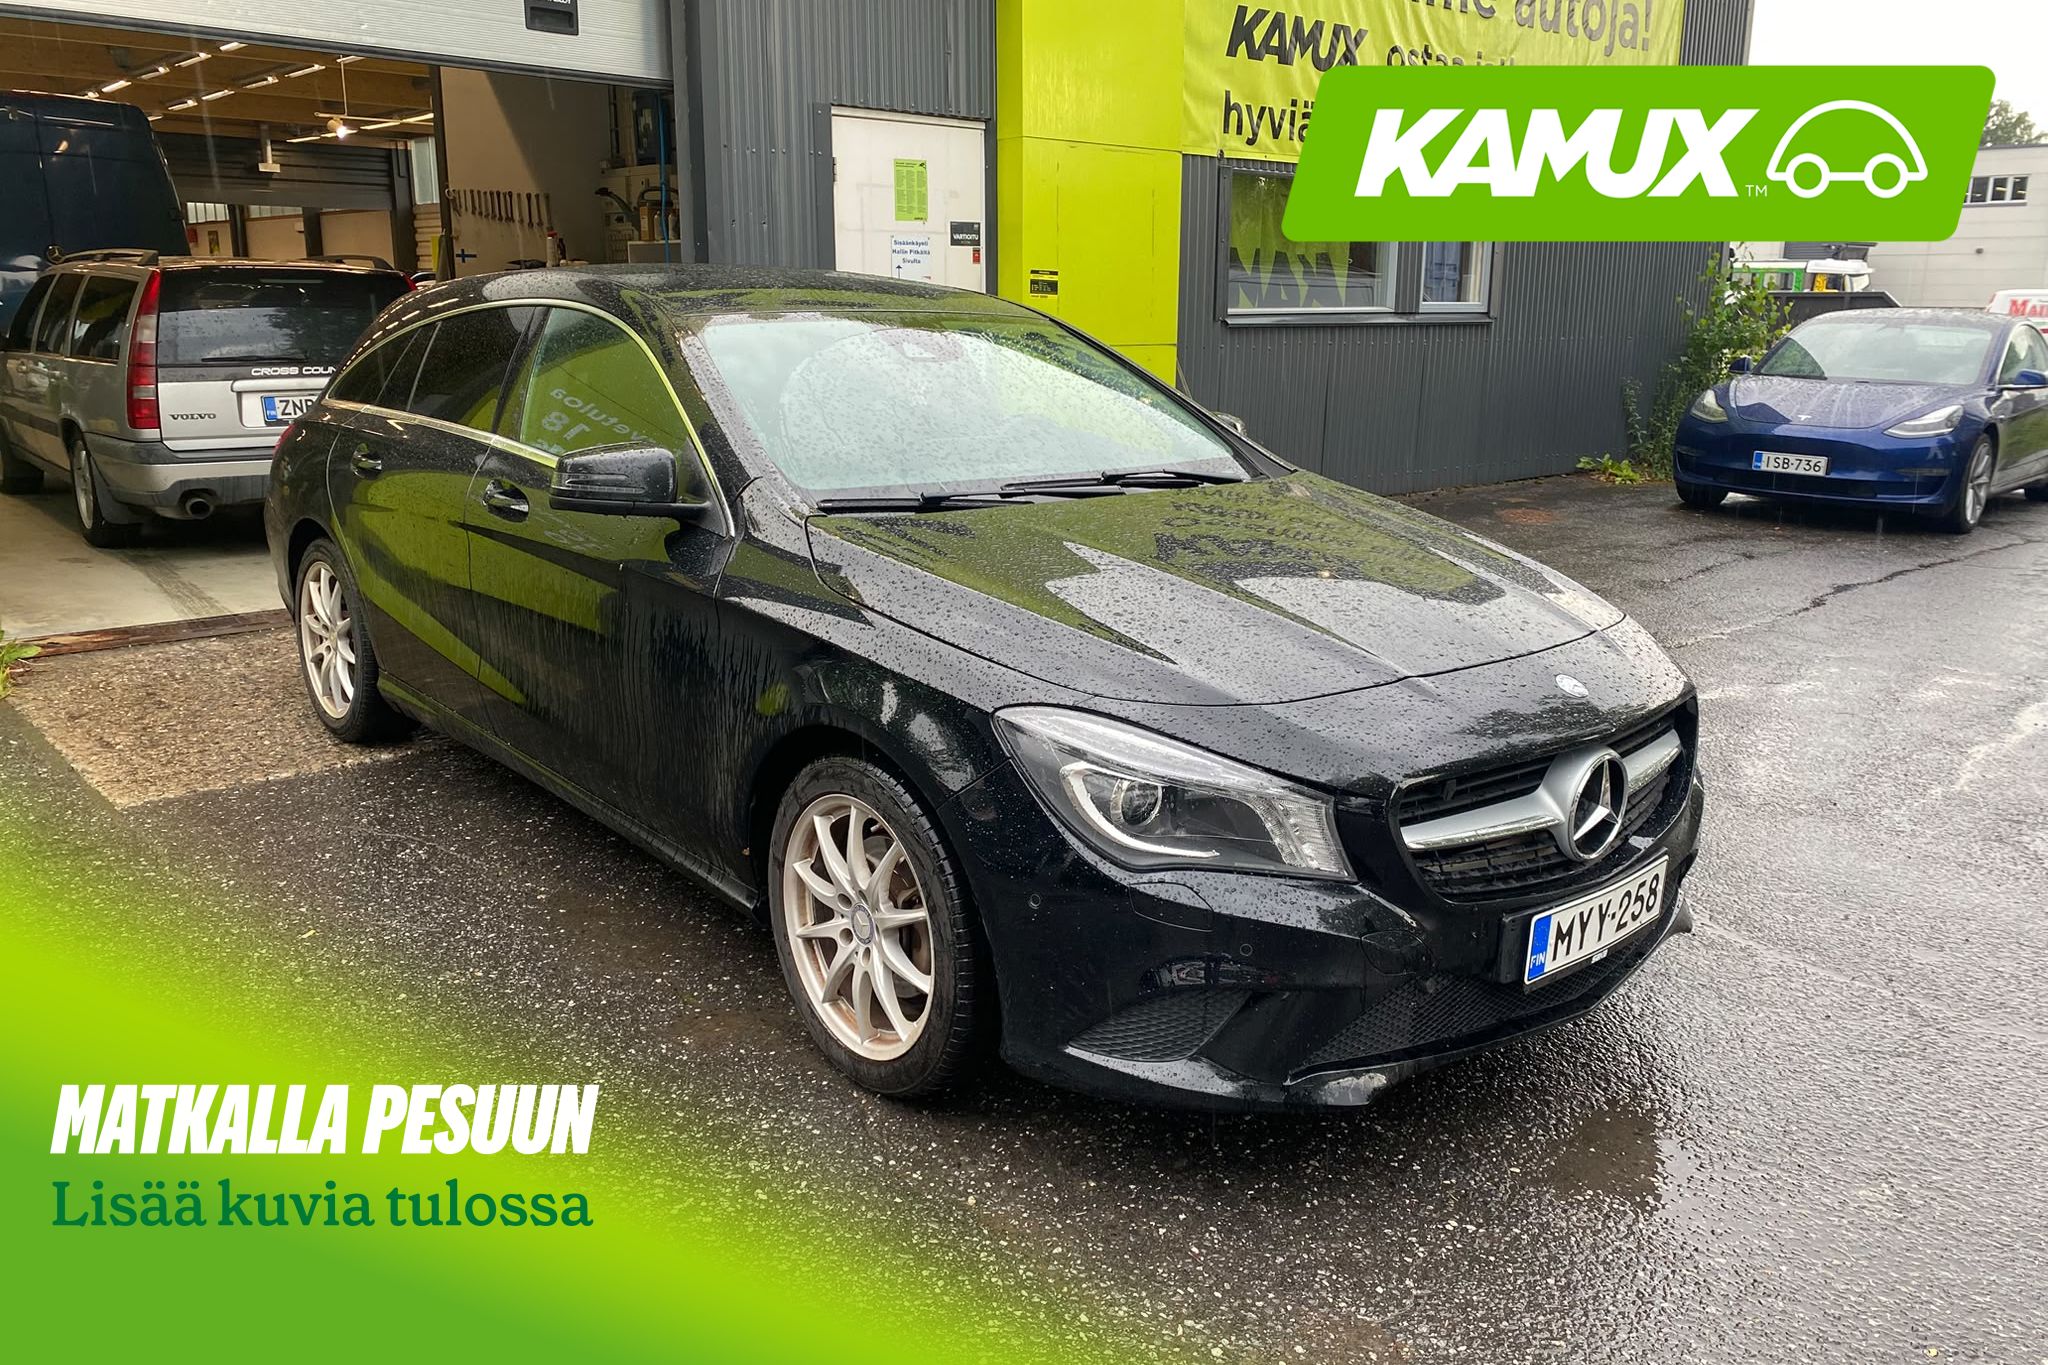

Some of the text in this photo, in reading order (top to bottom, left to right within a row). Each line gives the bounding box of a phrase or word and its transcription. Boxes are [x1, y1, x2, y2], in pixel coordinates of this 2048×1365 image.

[1225, 4, 1368, 72] KAMUX
[251, 366, 299, 376] CROSS
[169, 413, 216, 421] VOLVO
[1766, 456, 1822, 473] ISB-736
[1530, 872, 1660, 969] FIN MYY-258
